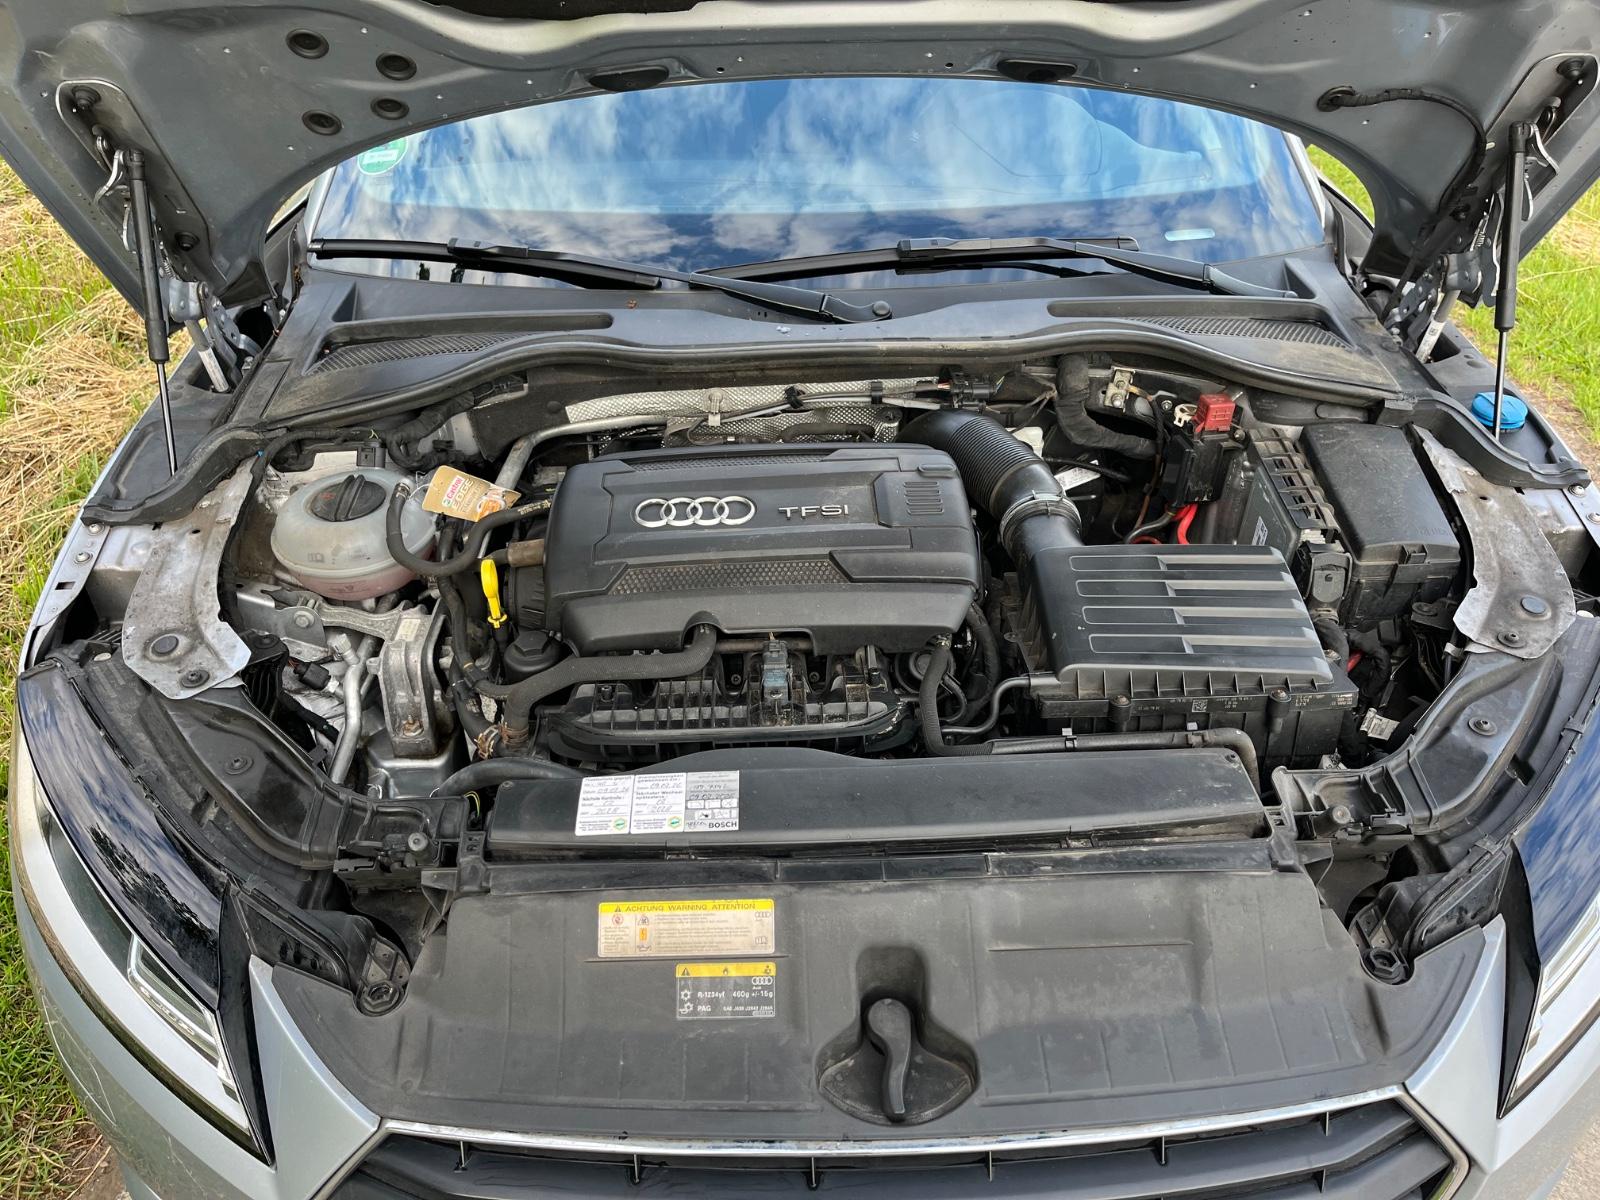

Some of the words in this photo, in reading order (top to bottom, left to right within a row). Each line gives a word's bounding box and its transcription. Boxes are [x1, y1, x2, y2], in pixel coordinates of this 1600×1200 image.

[446, 477, 463, 500] Castrol
[778, 504, 849, 519] TFSI
[708, 821, 737, 829] BOSCH
[697, 991, 725, 999] R-1234yf
